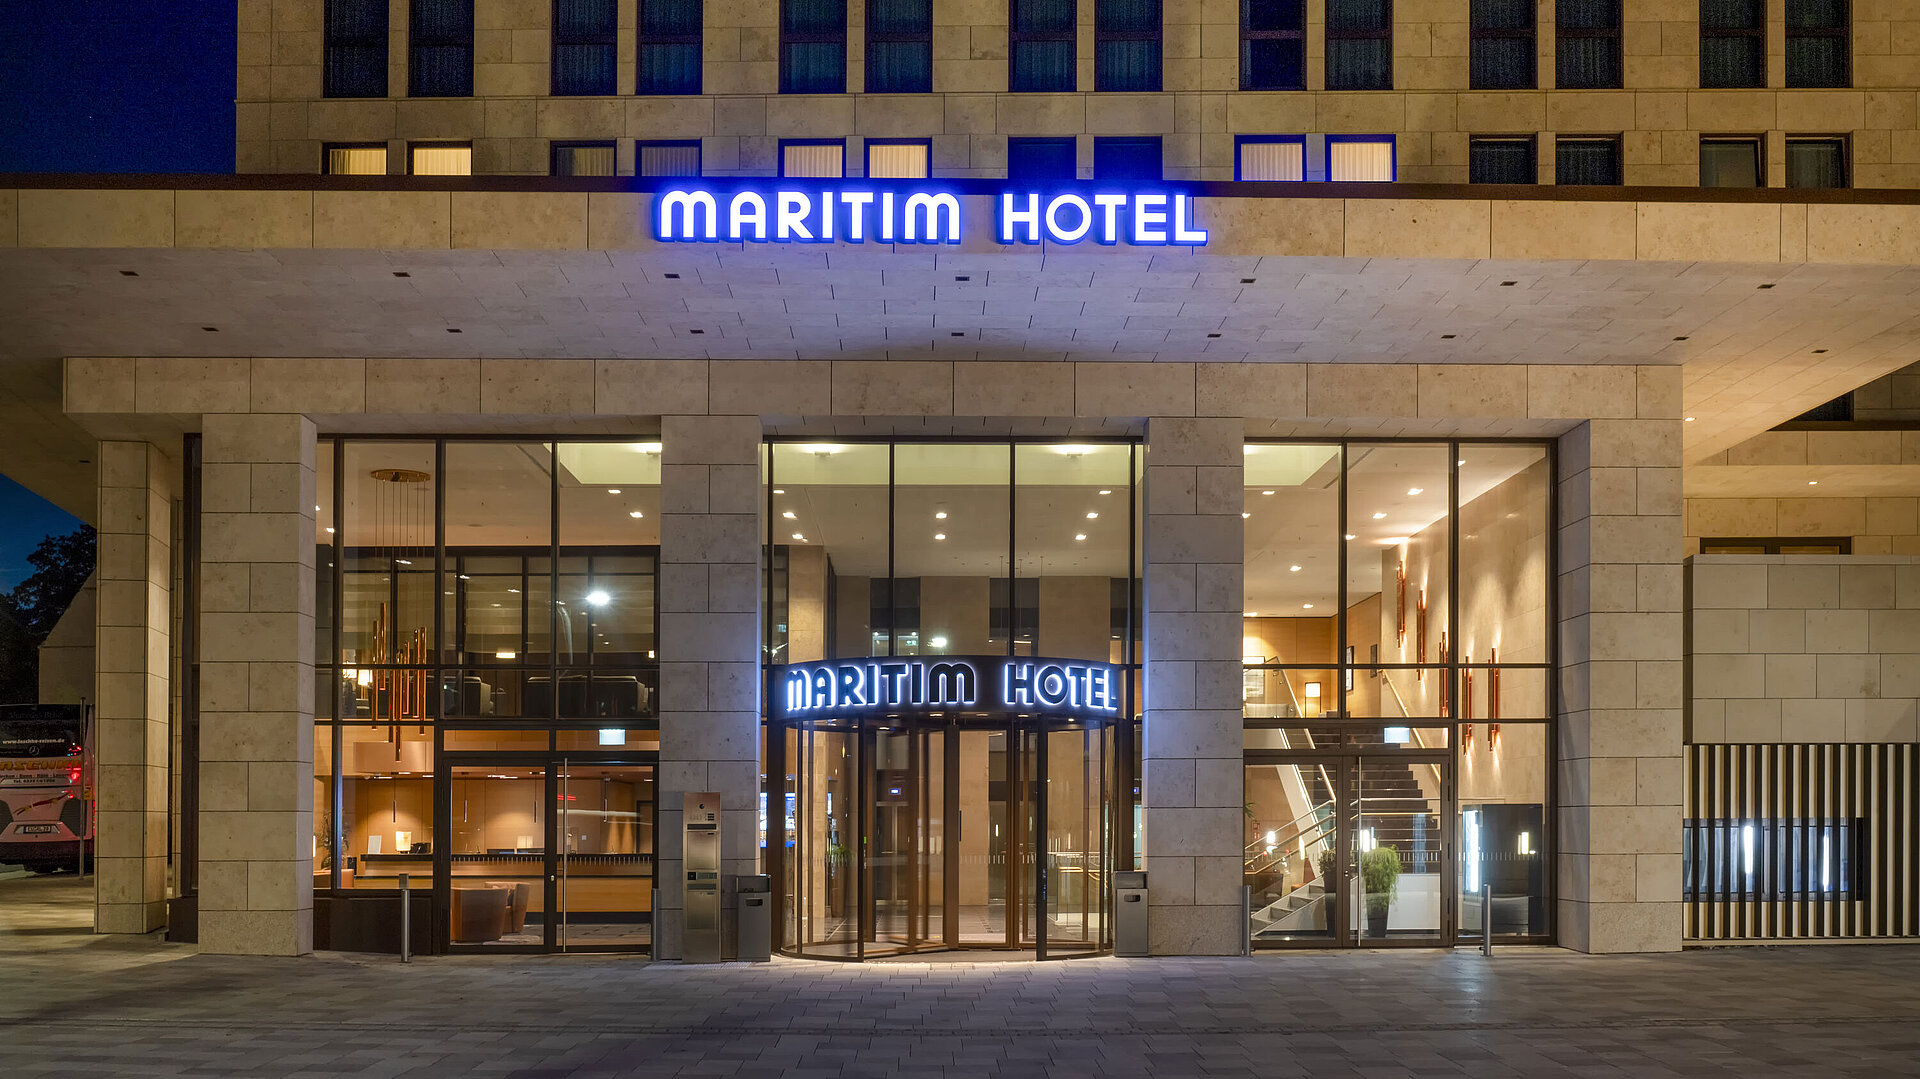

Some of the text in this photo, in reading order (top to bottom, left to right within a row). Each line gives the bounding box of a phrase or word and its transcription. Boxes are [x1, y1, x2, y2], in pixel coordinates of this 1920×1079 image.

[659, 190, 1208, 245] MARITIM HOTEL
[786, 662, 1118, 711] MARITIM HOTEL
